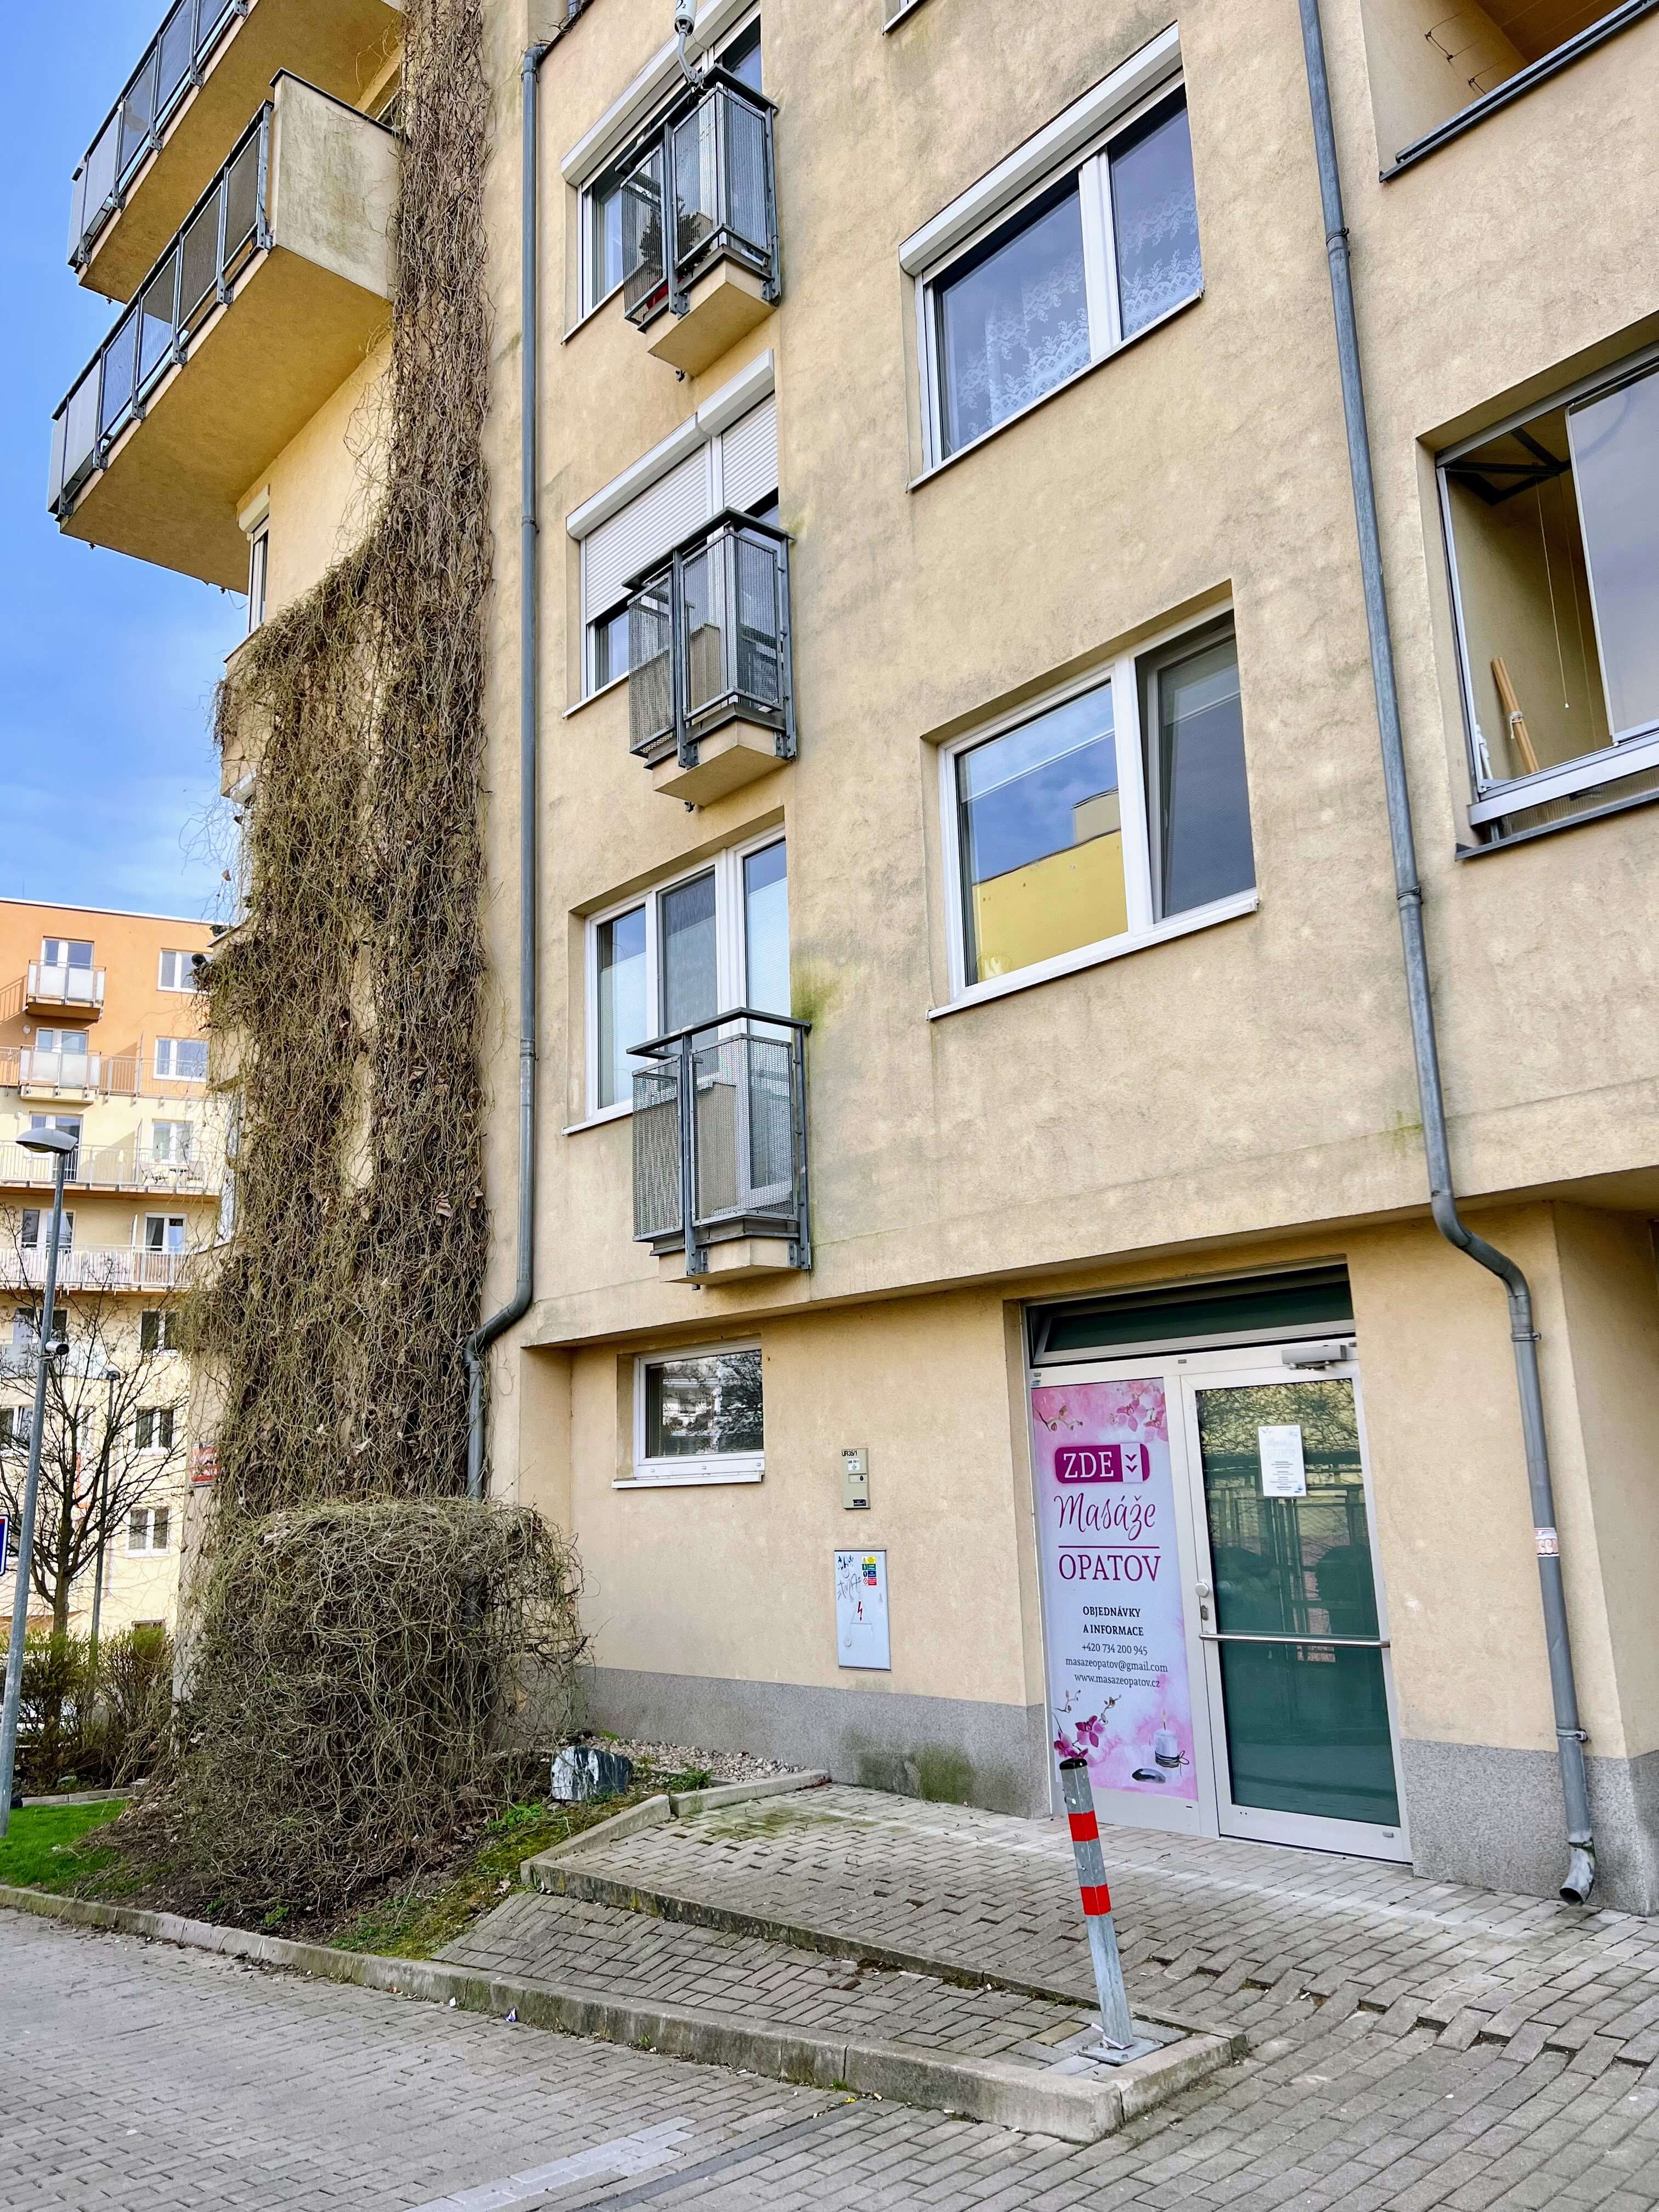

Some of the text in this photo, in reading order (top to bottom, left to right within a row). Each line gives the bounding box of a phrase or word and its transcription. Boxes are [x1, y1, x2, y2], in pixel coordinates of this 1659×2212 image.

[1063, 1451, 1114, 1479] ZDE
[1054, 1492, 1156, 1541] Masáže
[1059, 1554, 1161, 1582] OPATOV
[1083, 1606, 1141, 1618] OBJEDNÁVKY
[1083, 1624, 1144, 1636] A INFORMACE
[1082, 1642, 1148, 1656] +420 734 200 945
[1065, 1658, 1168, 1672] masazeopatov@gmail.com
[1074, 1674, 1160, 1688] www.masazeopatov.cz
